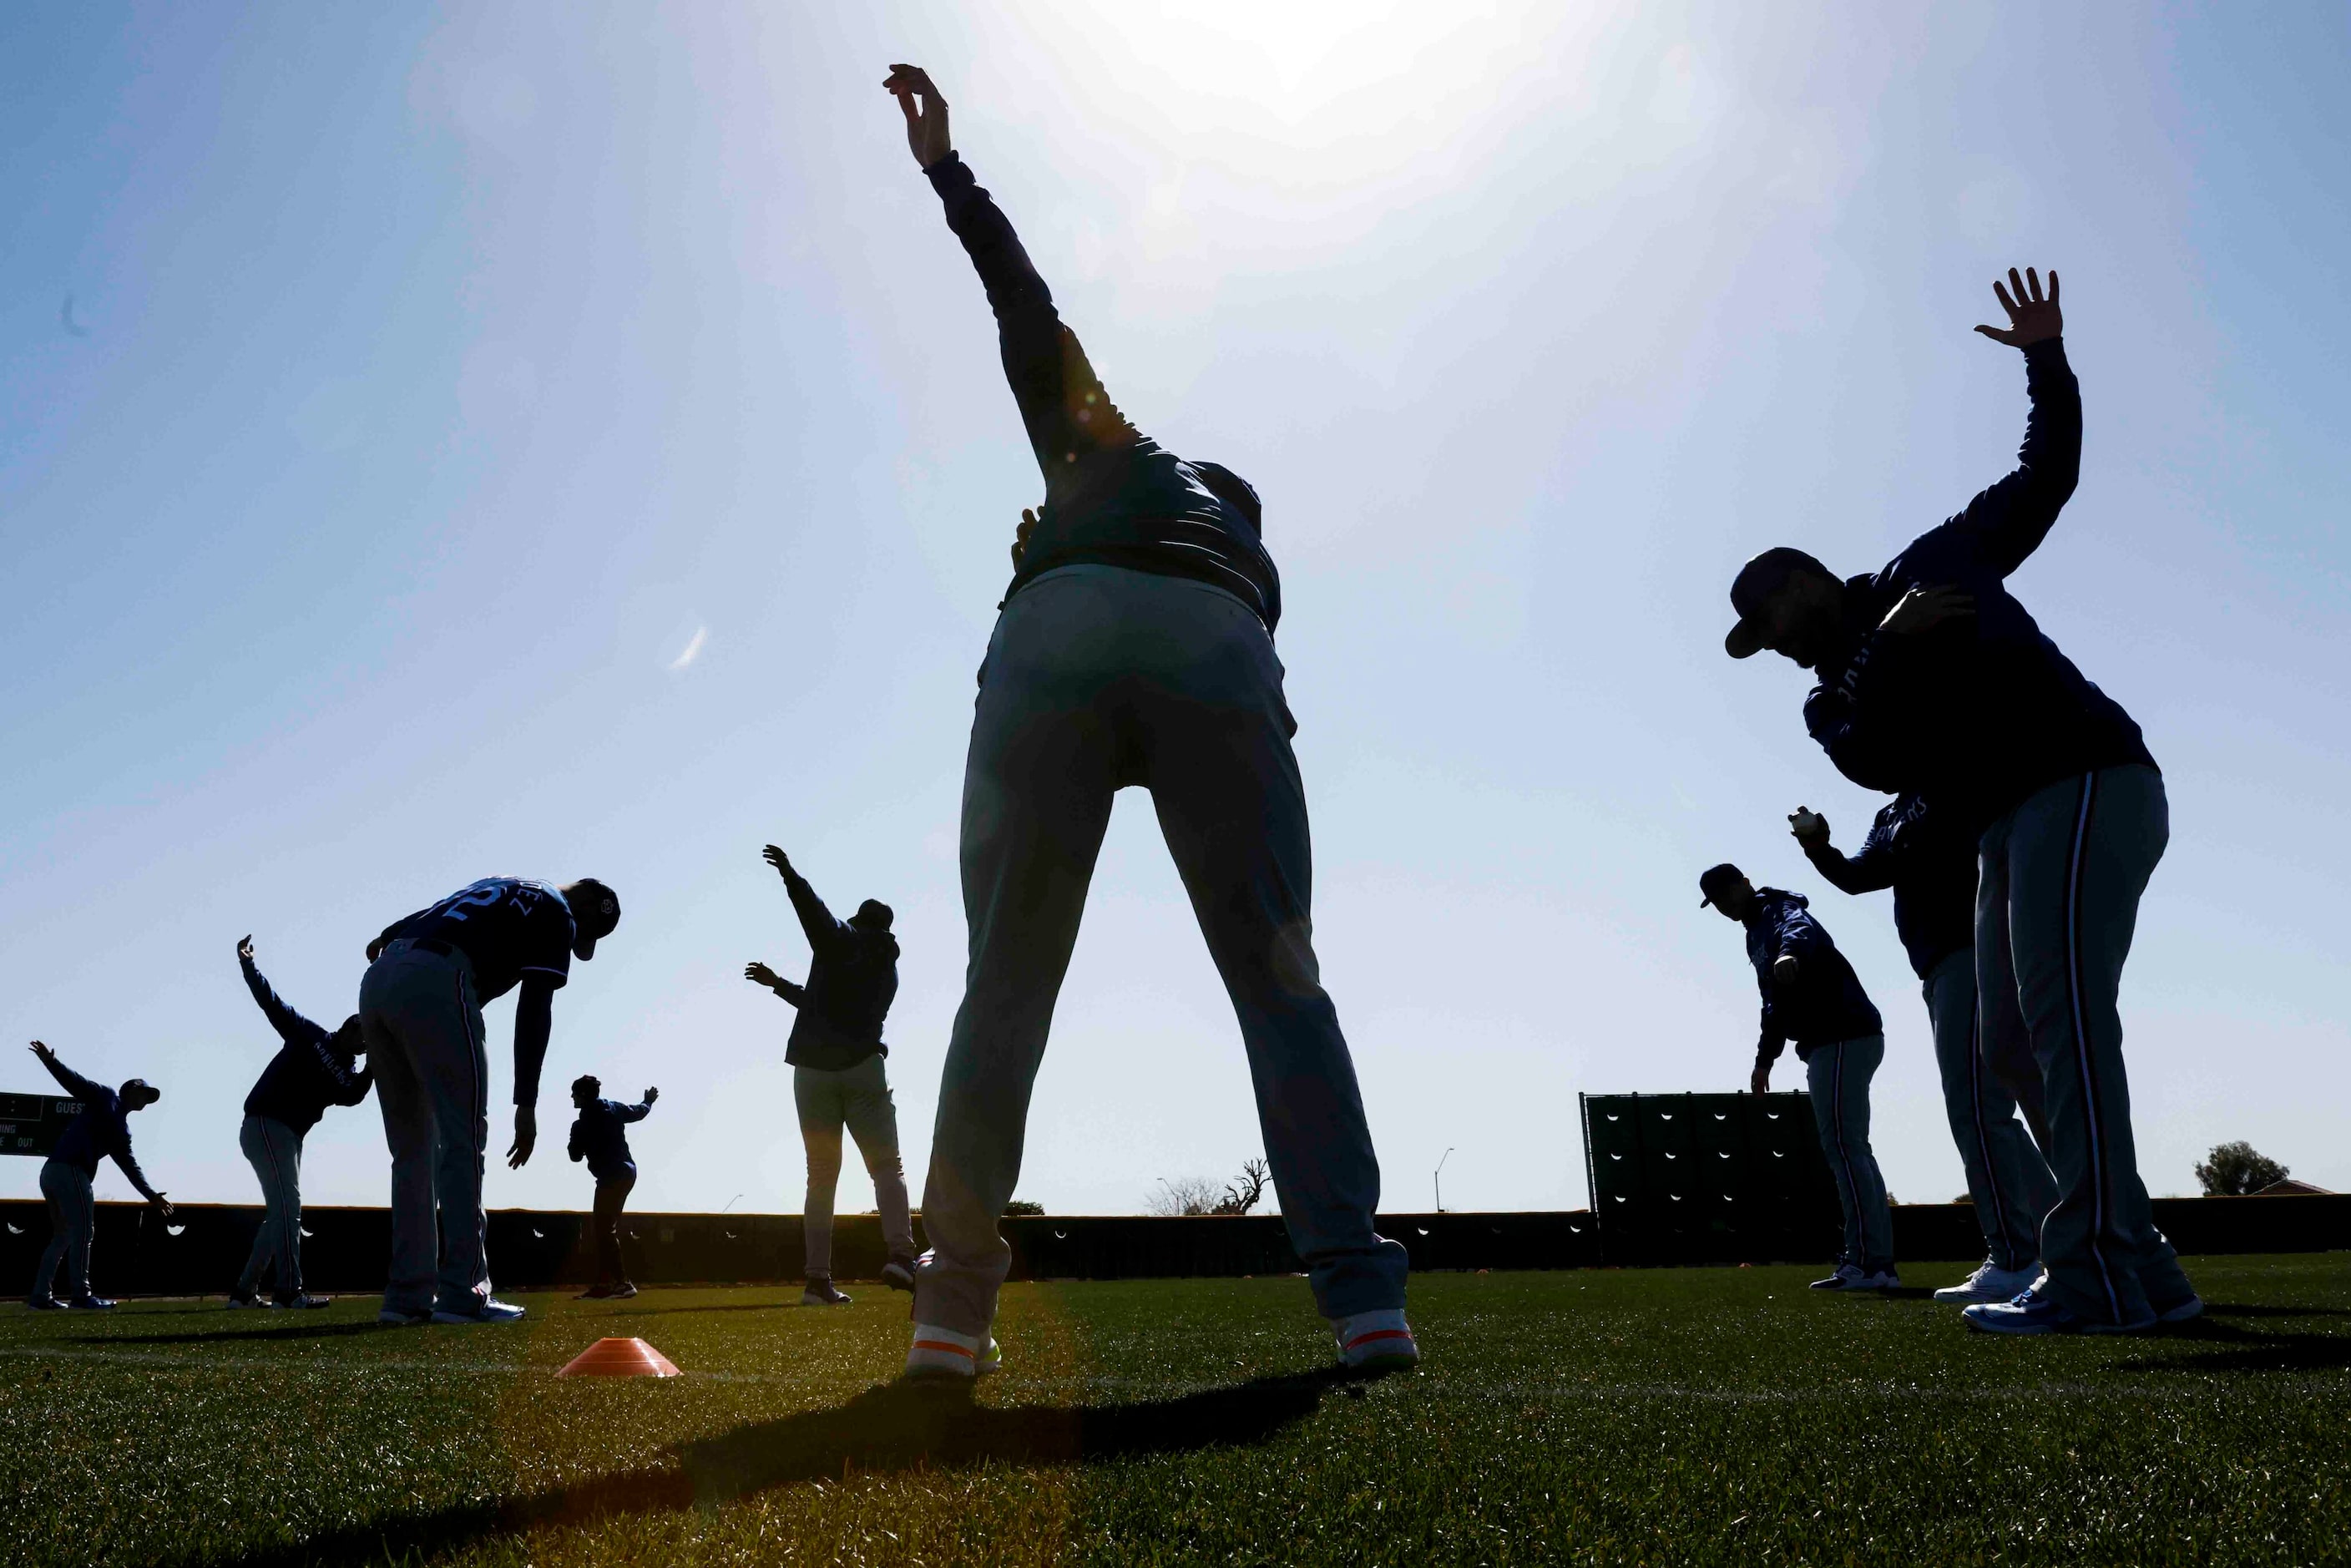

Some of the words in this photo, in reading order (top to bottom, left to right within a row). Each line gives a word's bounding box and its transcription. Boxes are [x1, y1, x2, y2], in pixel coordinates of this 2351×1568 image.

[55, 1101, 86, 1114] GUES
[0, 1124, 16, 1134] ING
[18, 1136, 33, 1147] OUT
